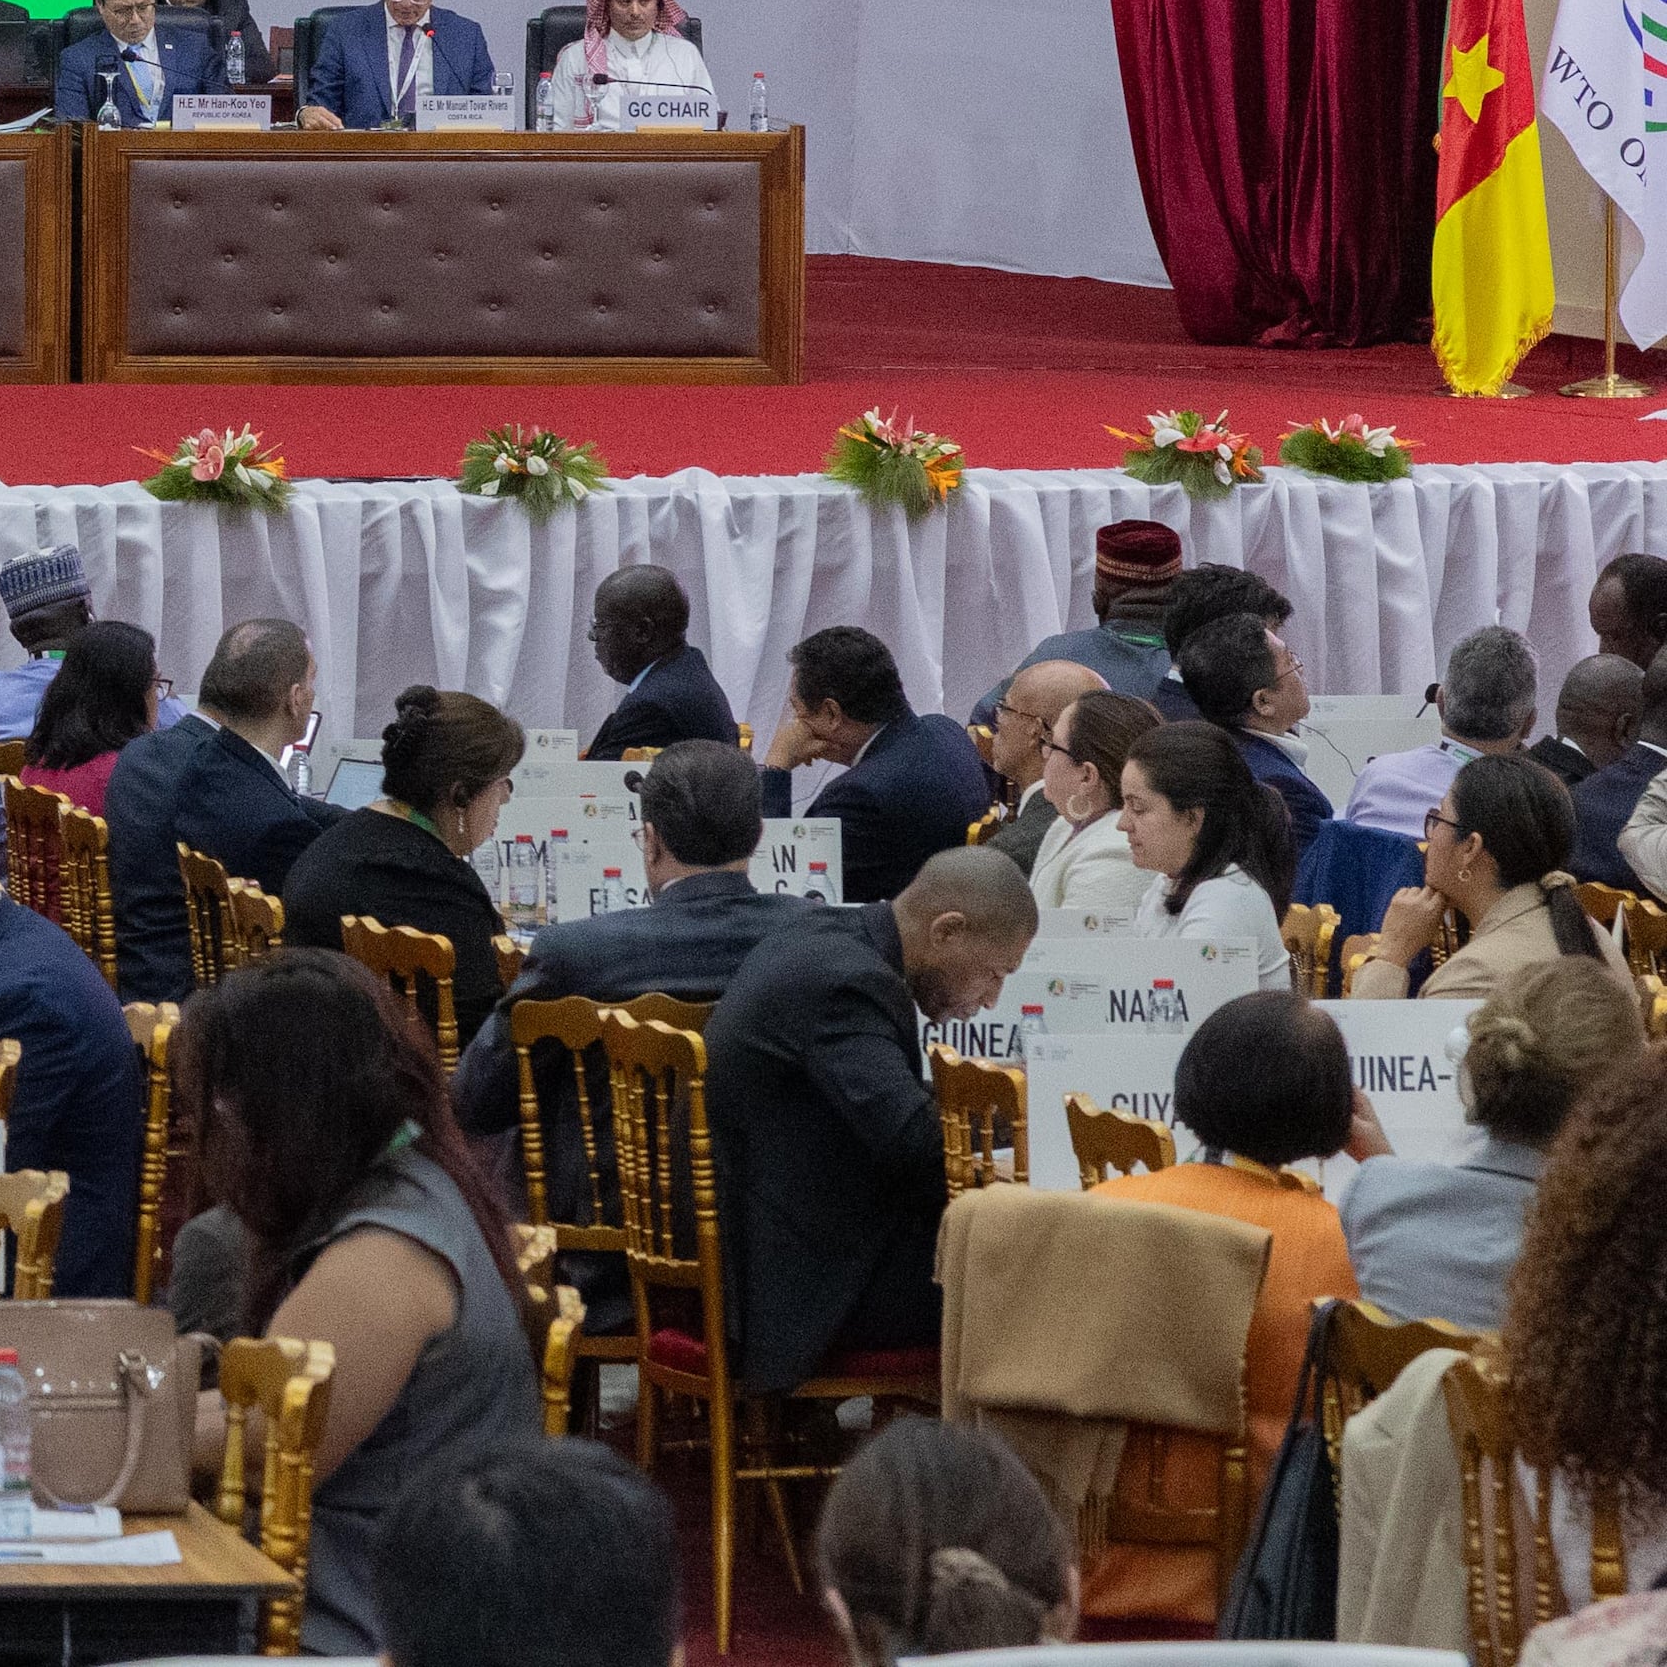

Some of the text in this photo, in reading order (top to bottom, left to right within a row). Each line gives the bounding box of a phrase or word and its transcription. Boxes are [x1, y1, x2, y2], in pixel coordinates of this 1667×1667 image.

[178, 98, 267, 110] H.E. Mr Han-Koo Yeo
[628, 102, 709, 117] GC CHAIR
